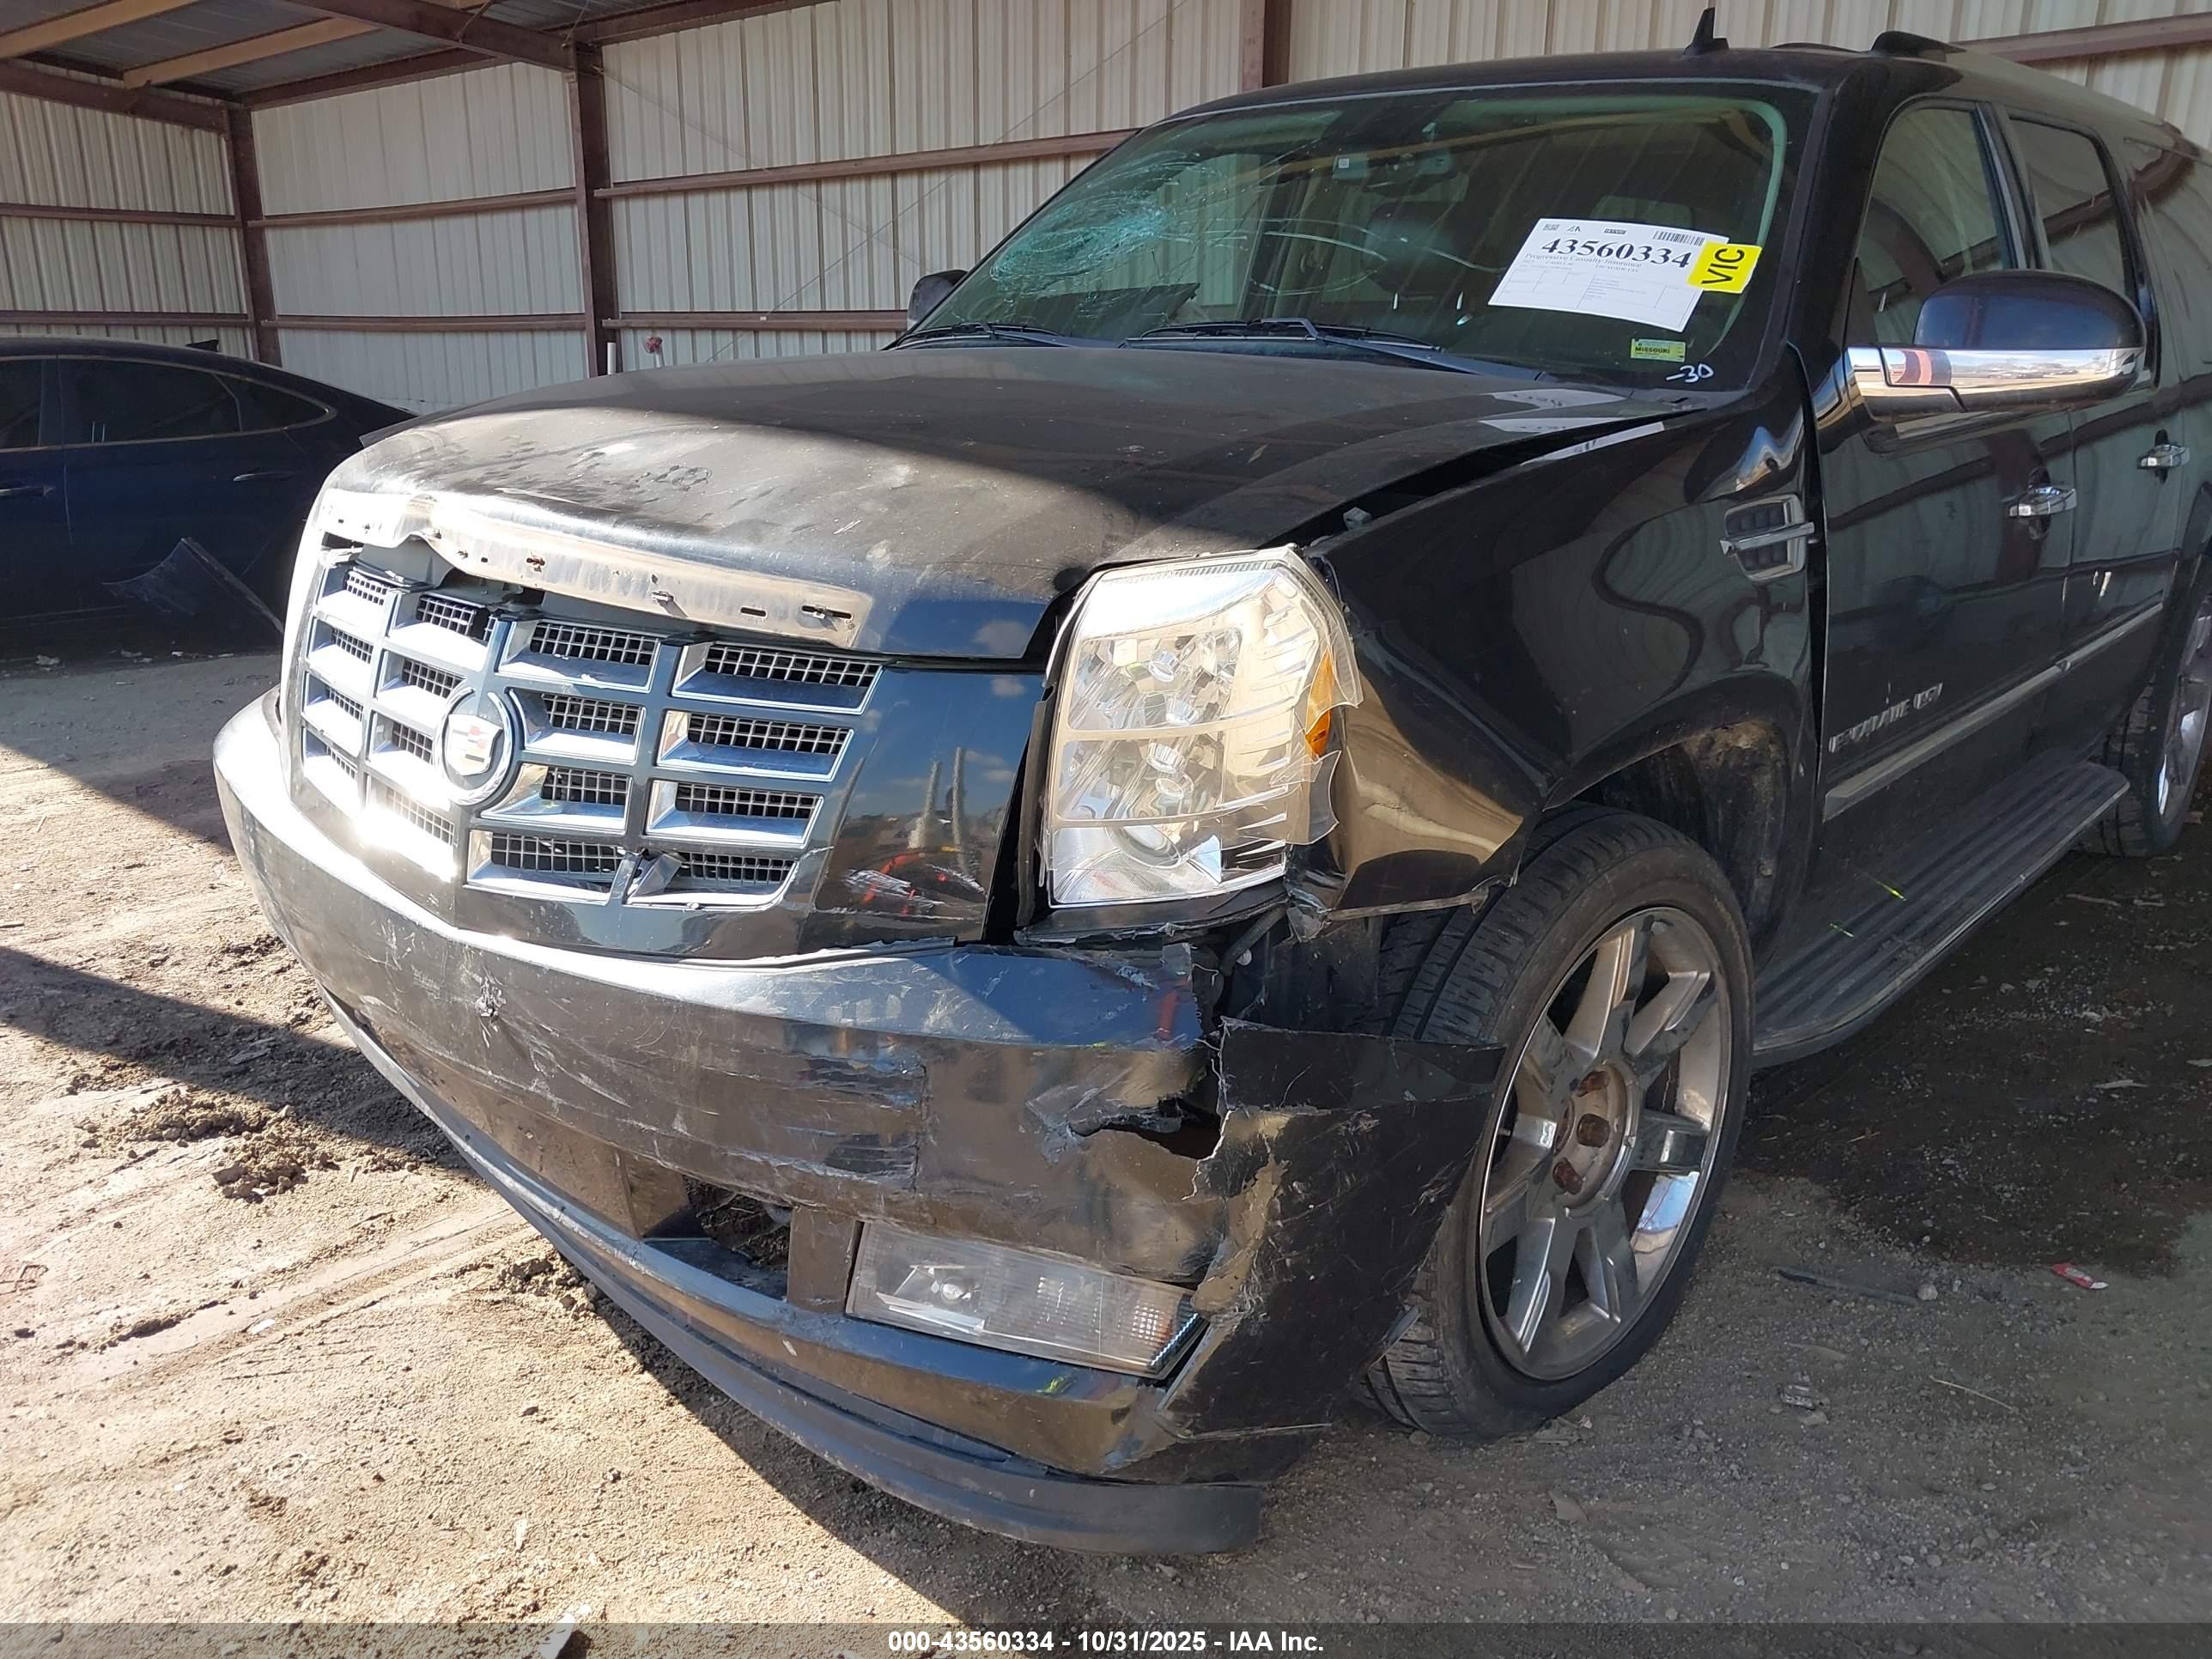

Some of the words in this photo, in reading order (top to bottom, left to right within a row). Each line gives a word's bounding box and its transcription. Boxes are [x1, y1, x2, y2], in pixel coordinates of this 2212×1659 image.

[1525, 252, 1567, 262] Progressive
[1541, 238, 1692, 269] 43560334
[1701, 247, 1746, 285] VIC
